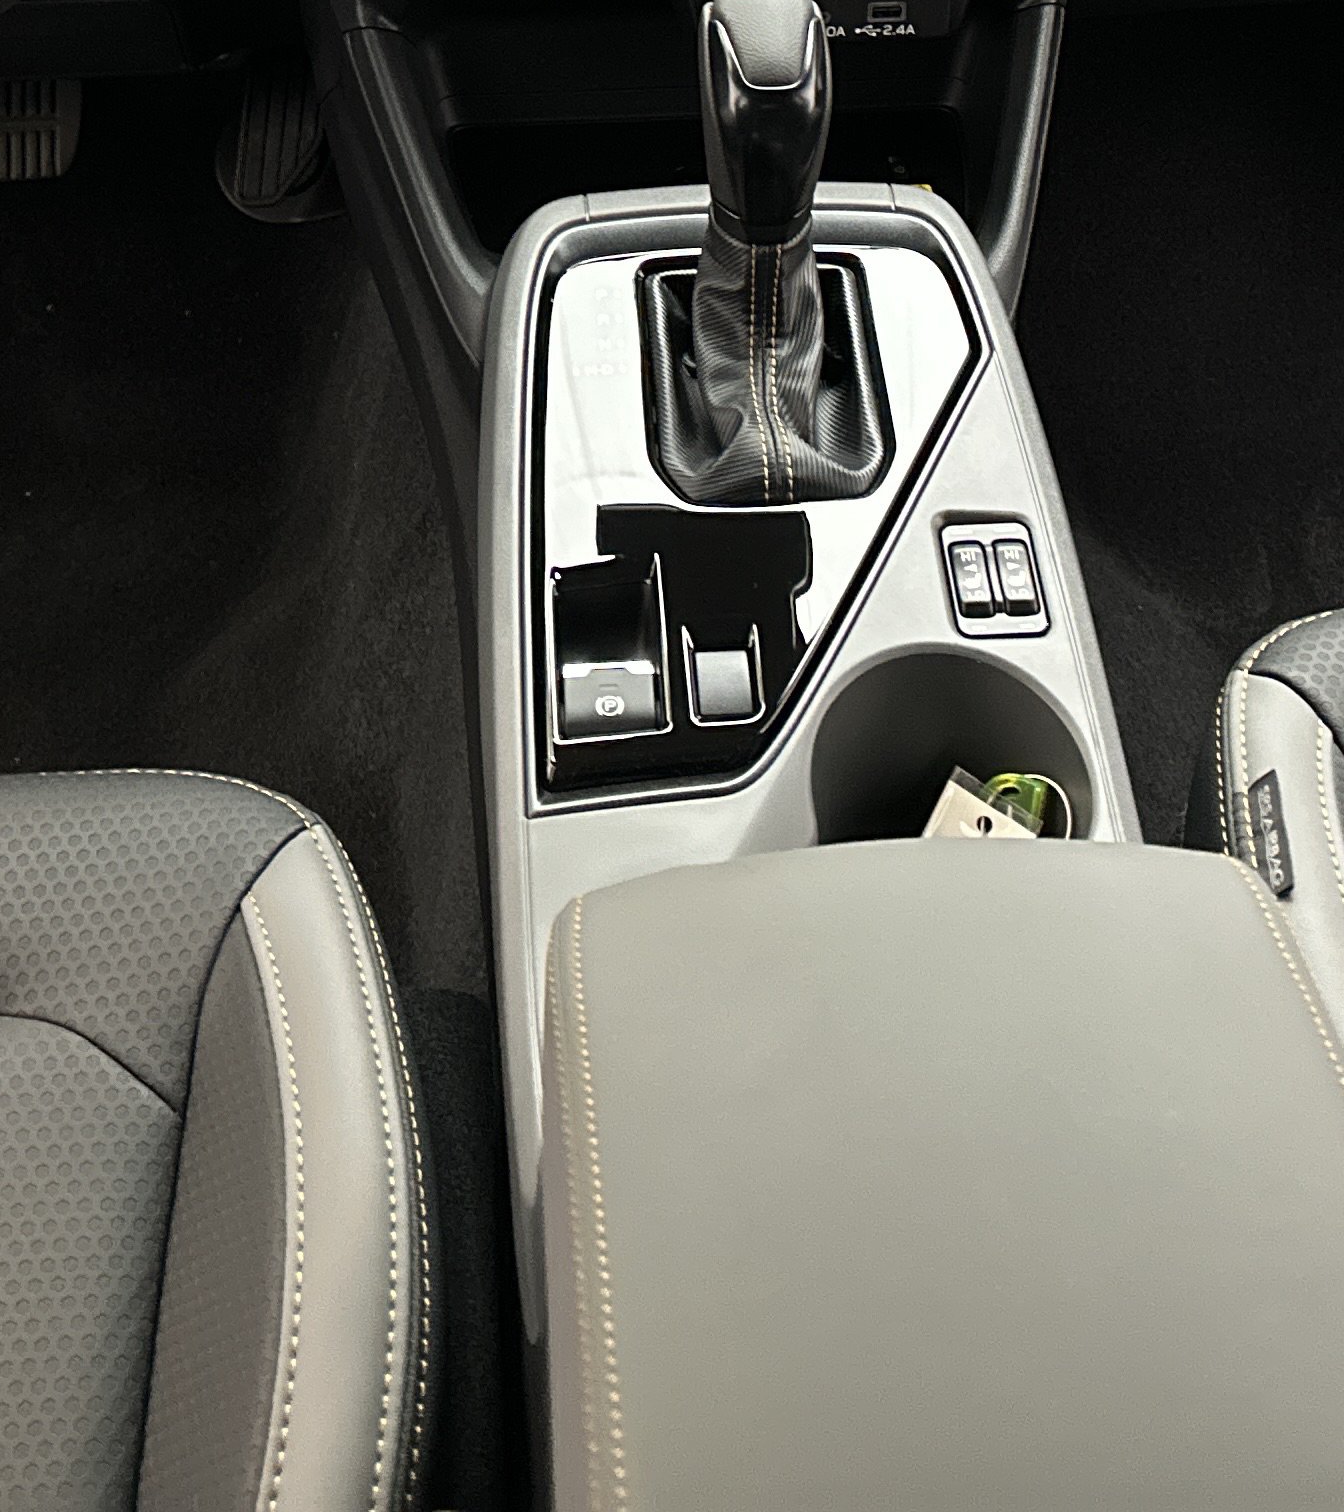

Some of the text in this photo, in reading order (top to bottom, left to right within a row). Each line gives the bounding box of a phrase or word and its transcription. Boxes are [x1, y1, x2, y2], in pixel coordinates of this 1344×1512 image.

[882, 24, 915, 36] 2.4A
[959, 550, 977, 562] HI
[1003, 549, 1020, 560] HI
[1261, 818, 1285, 889] AIRBAG
